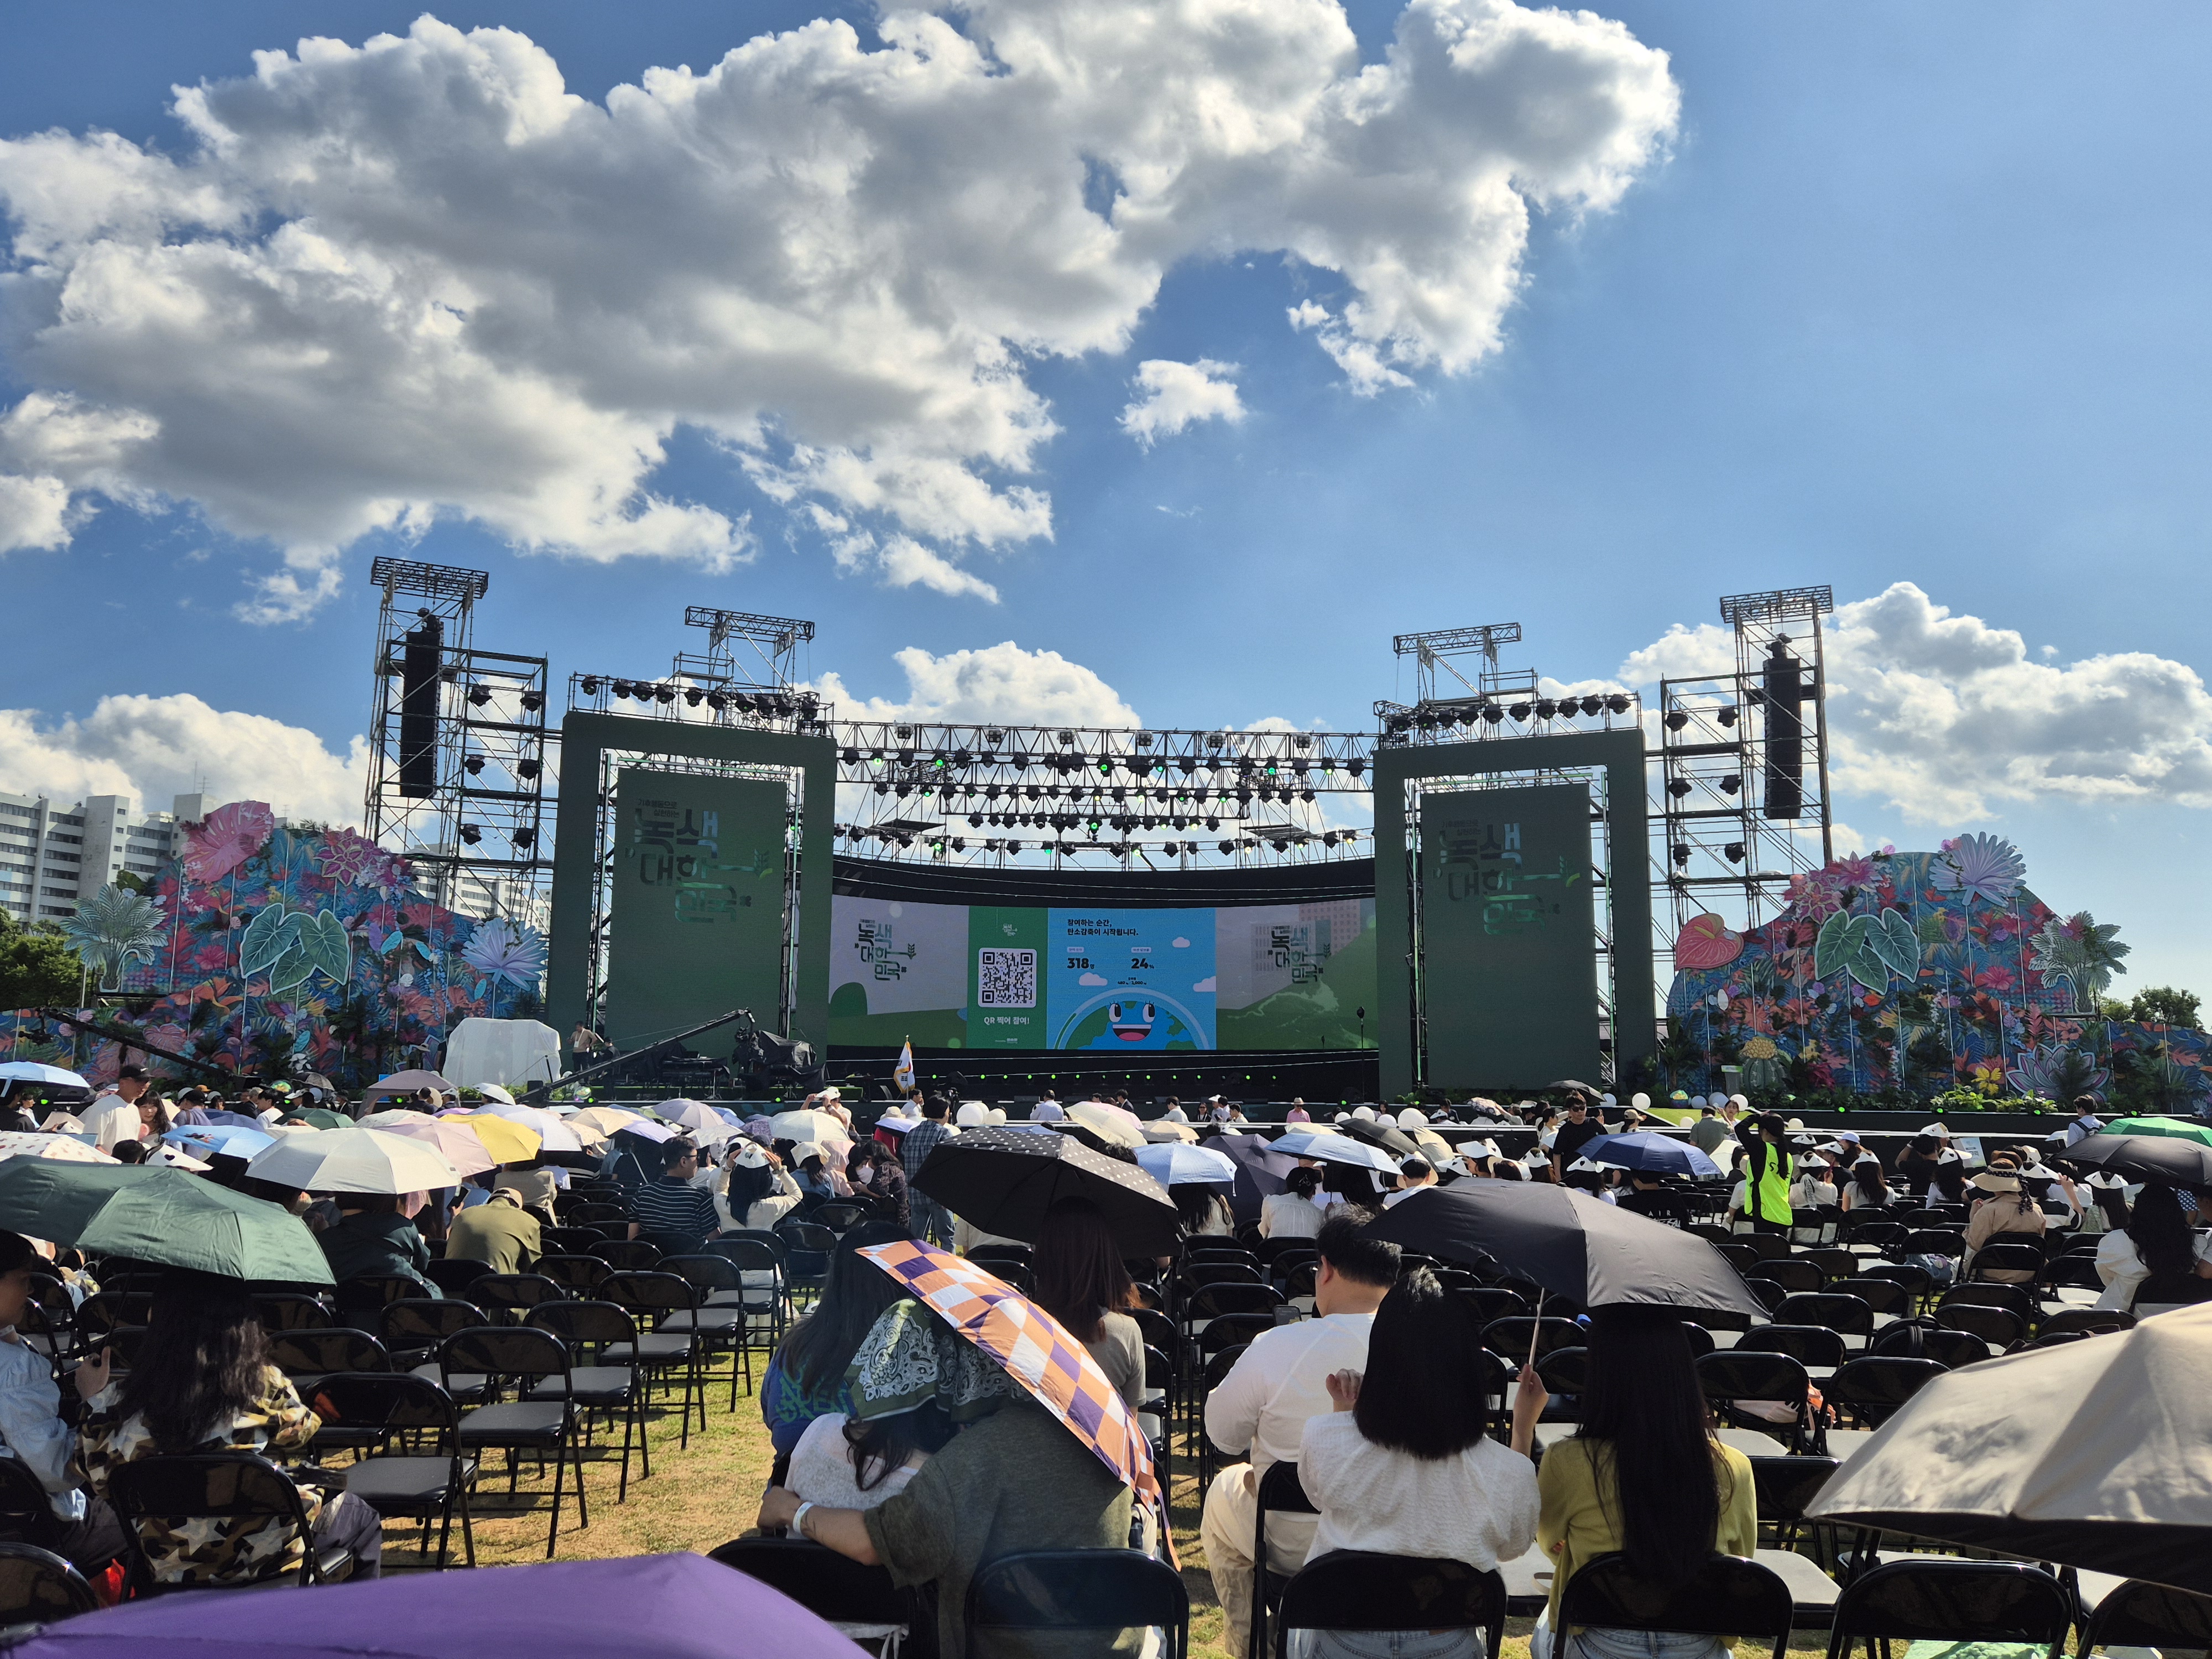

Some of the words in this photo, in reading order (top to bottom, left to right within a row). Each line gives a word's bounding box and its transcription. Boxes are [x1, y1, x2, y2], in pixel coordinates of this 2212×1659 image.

[654, 808, 680, 817] 실현하는
[634, 808, 719, 858] 녹색
[1439, 823, 1522, 869] 녹색
[1096, 919, 1112, 927] 순간,
[858, 923, 892, 949] 녹색
[984, 1016, 995, 1025] QR
[997, 1016, 1011, 1025] 찍어
[1013, 1016, 1030, 1025] 참여!
